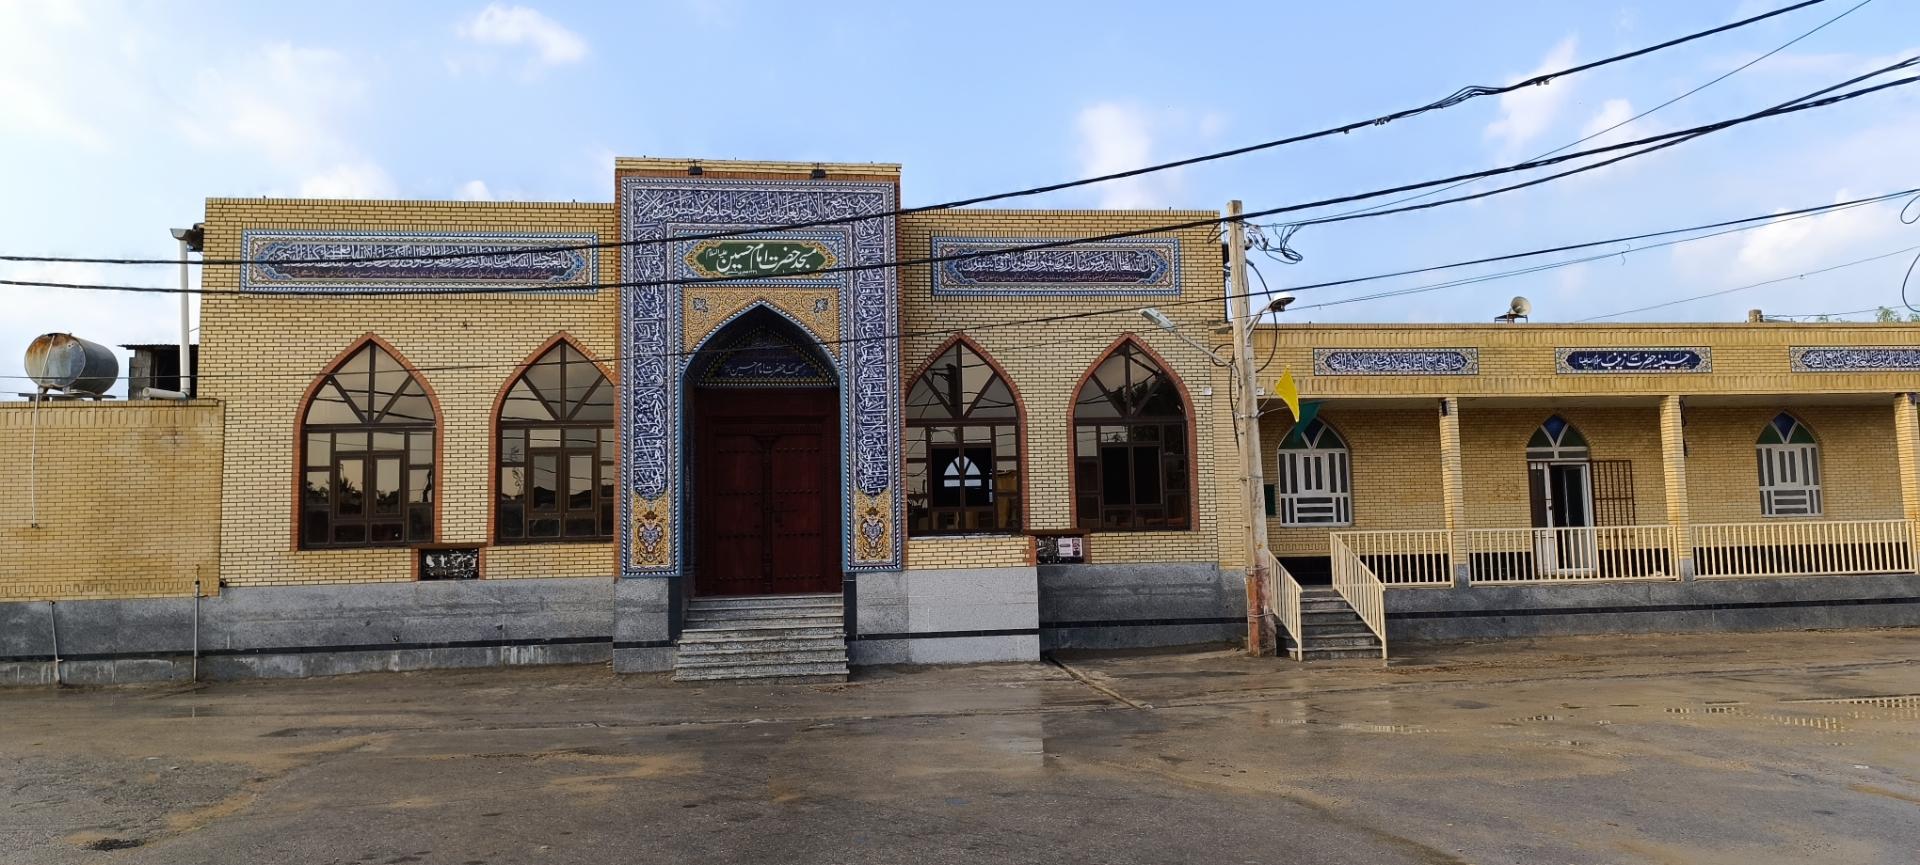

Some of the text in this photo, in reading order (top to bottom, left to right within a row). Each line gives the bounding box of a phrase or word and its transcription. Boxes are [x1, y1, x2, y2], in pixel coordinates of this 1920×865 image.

[716, 245, 754, 273] حسین
[749, 243, 769, 271] امام
[758, 246, 801, 272] حضرت
[789, 247, 817, 269] مسجد
[1600, 352, 1627, 370] زینب
[1626, 353, 1656, 370] حضرت
[1645, 352, 1690, 369] حسینیه
